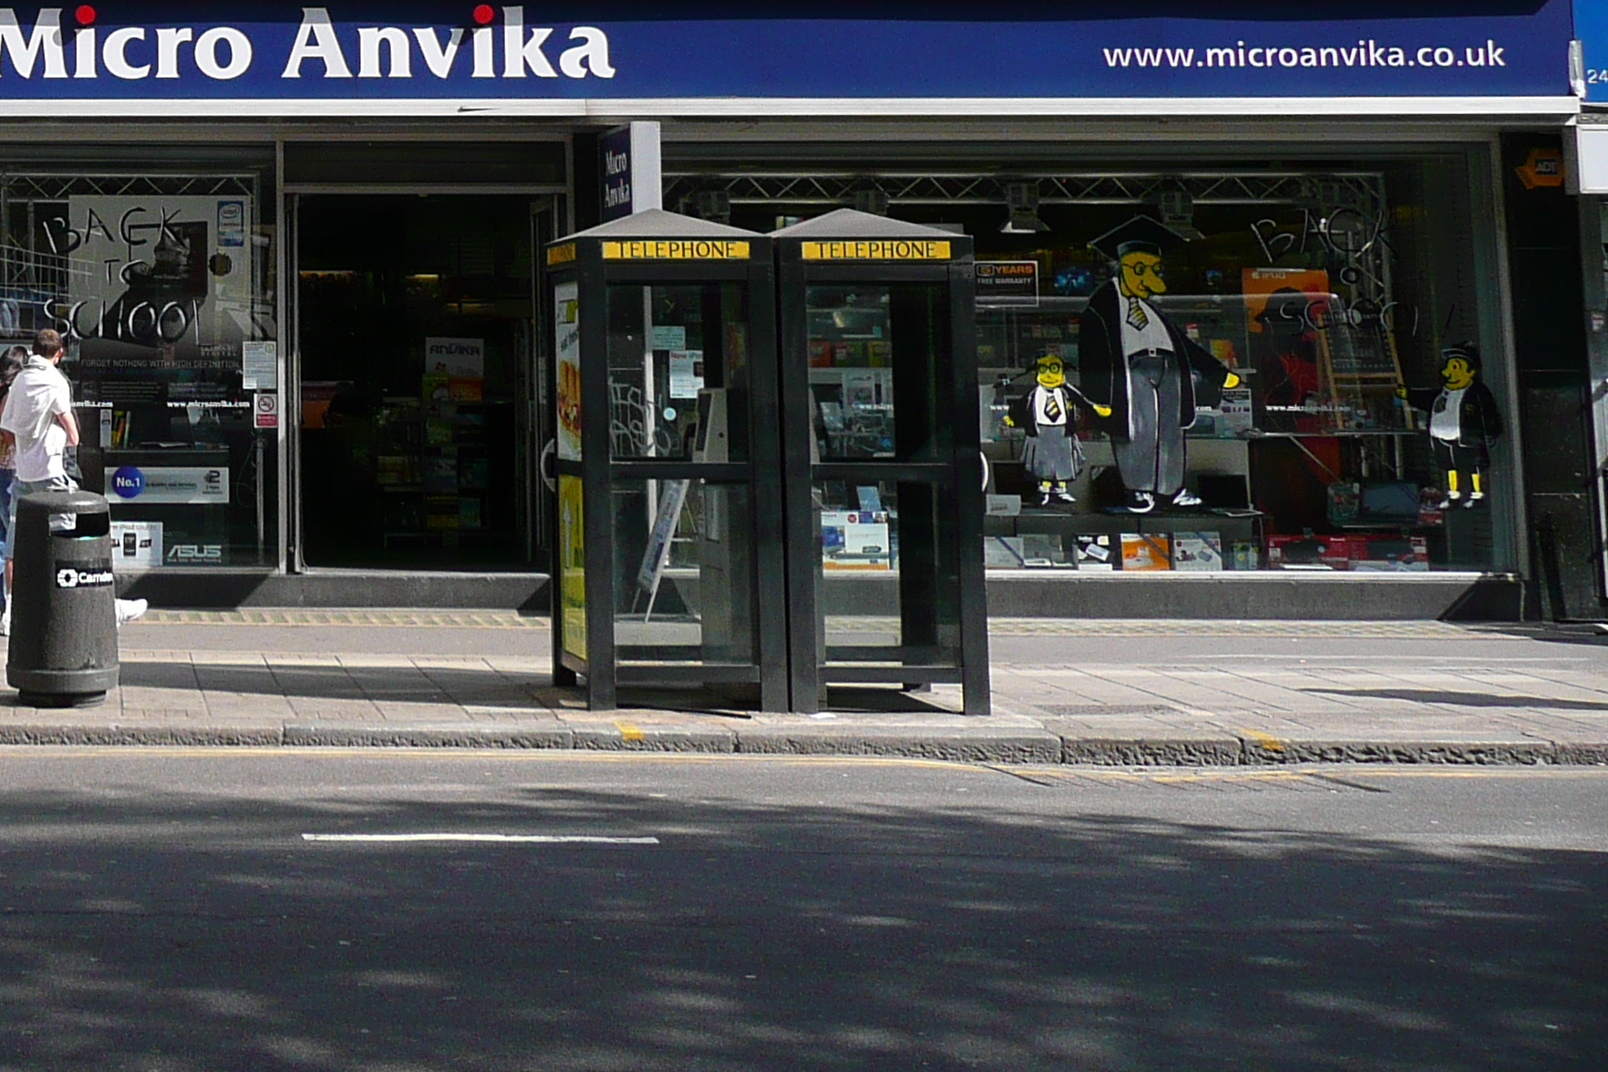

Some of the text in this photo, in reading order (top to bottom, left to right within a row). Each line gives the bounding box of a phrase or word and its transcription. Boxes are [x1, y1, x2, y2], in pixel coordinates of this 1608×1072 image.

[281, 3, 616, 79] Anvika
[1103, 39, 1505, 68] www.microanvika.co.uk
[605, 150, 628, 176] Micro
[604, 179, 631, 208] Anvika
[42, 205, 190, 254] BACK
[616, 241, 738, 258] TELEPHONE
[815, 241, 938, 259] TELEPHONE
[995, 266, 1033, 274] YEARS
[43, 299, 219, 347] SCHOOL
[80, 359, 111, 368] FORGET
[113, 359, 148, 368] NOTHING
[149, 360, 171, 368] WITH
[115, 476, 141, 488] No.1
[167, 545, 222, 557] ASUS
